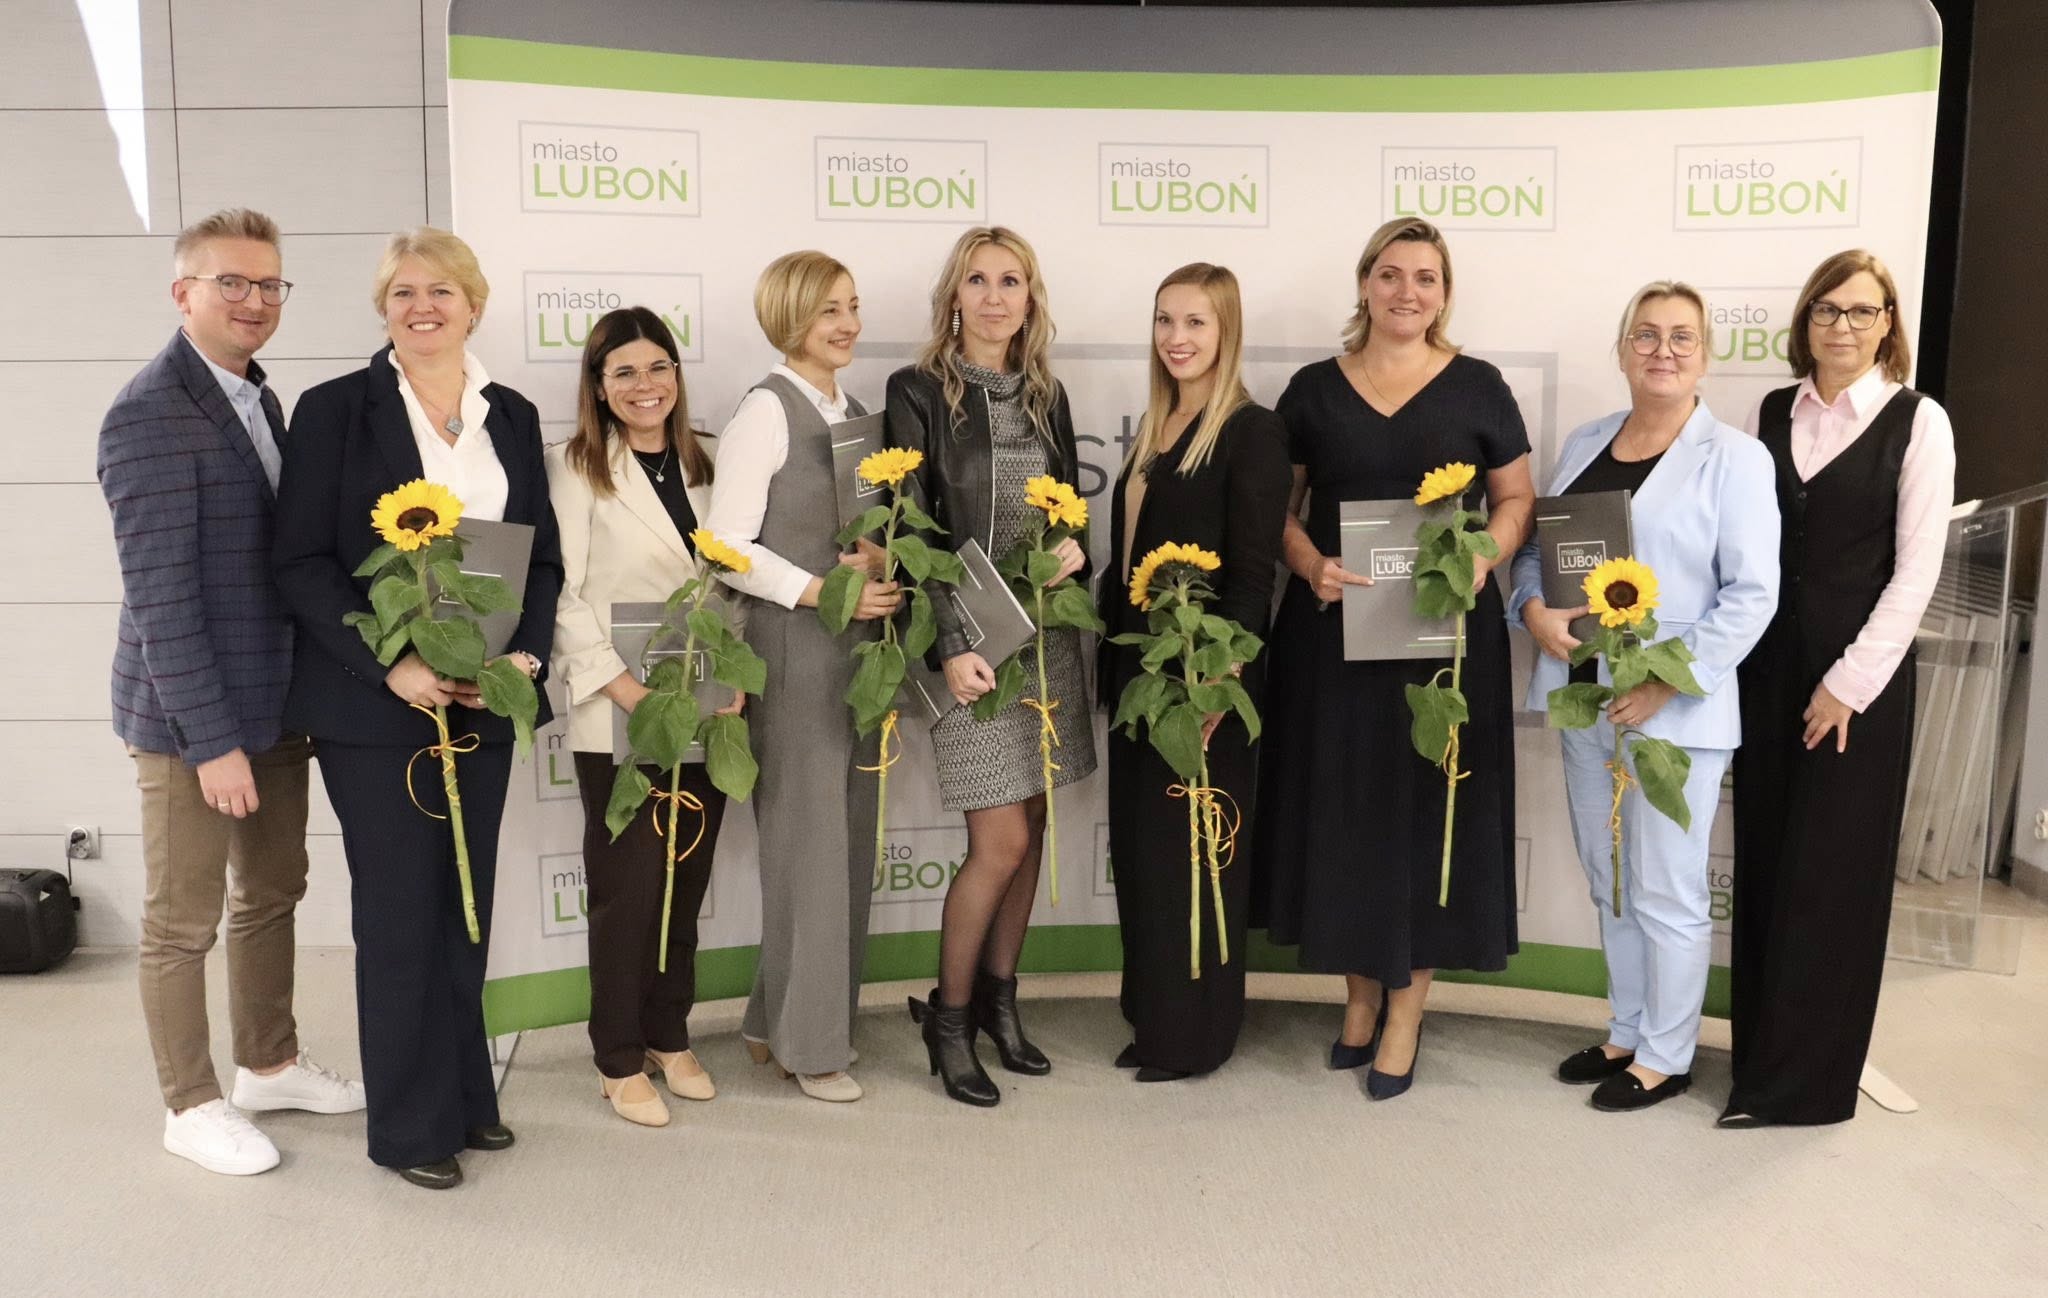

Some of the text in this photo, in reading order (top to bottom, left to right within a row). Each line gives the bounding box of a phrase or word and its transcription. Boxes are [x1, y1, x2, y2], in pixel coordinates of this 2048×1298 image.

[533, 138, 618, 162] miasto
[828, 152, 909, 173] miasto
[1111, 157, 1191, 178] miasto
[1394, 161, 1476, 181] miasto
[1688, 158, 1775, 180] miasto
[533, 160, 688, 202] LUBOŃ
[828, 169, 975, 209] LUBOŃ
[1111, 174, 1257, 213] LUBOŃ
[1394, 177, 1544, 217] LUBOŃ
[1687, 169, 1847, 216] LUBOŃ
[537, 287, 621, 309] miasto
[1708, 302, 1768, 324] iasto
[538, 305, 690, 347] LUŃ
[1710, 328, 1792, 361] UBO
[1376, 553, 1405, 562] miasto
[1561, 548, 1584, 556] miasto
[1561, 551, 1603, 569] LUBOŃ
[1376, 561, 1415, 575] LUBO
